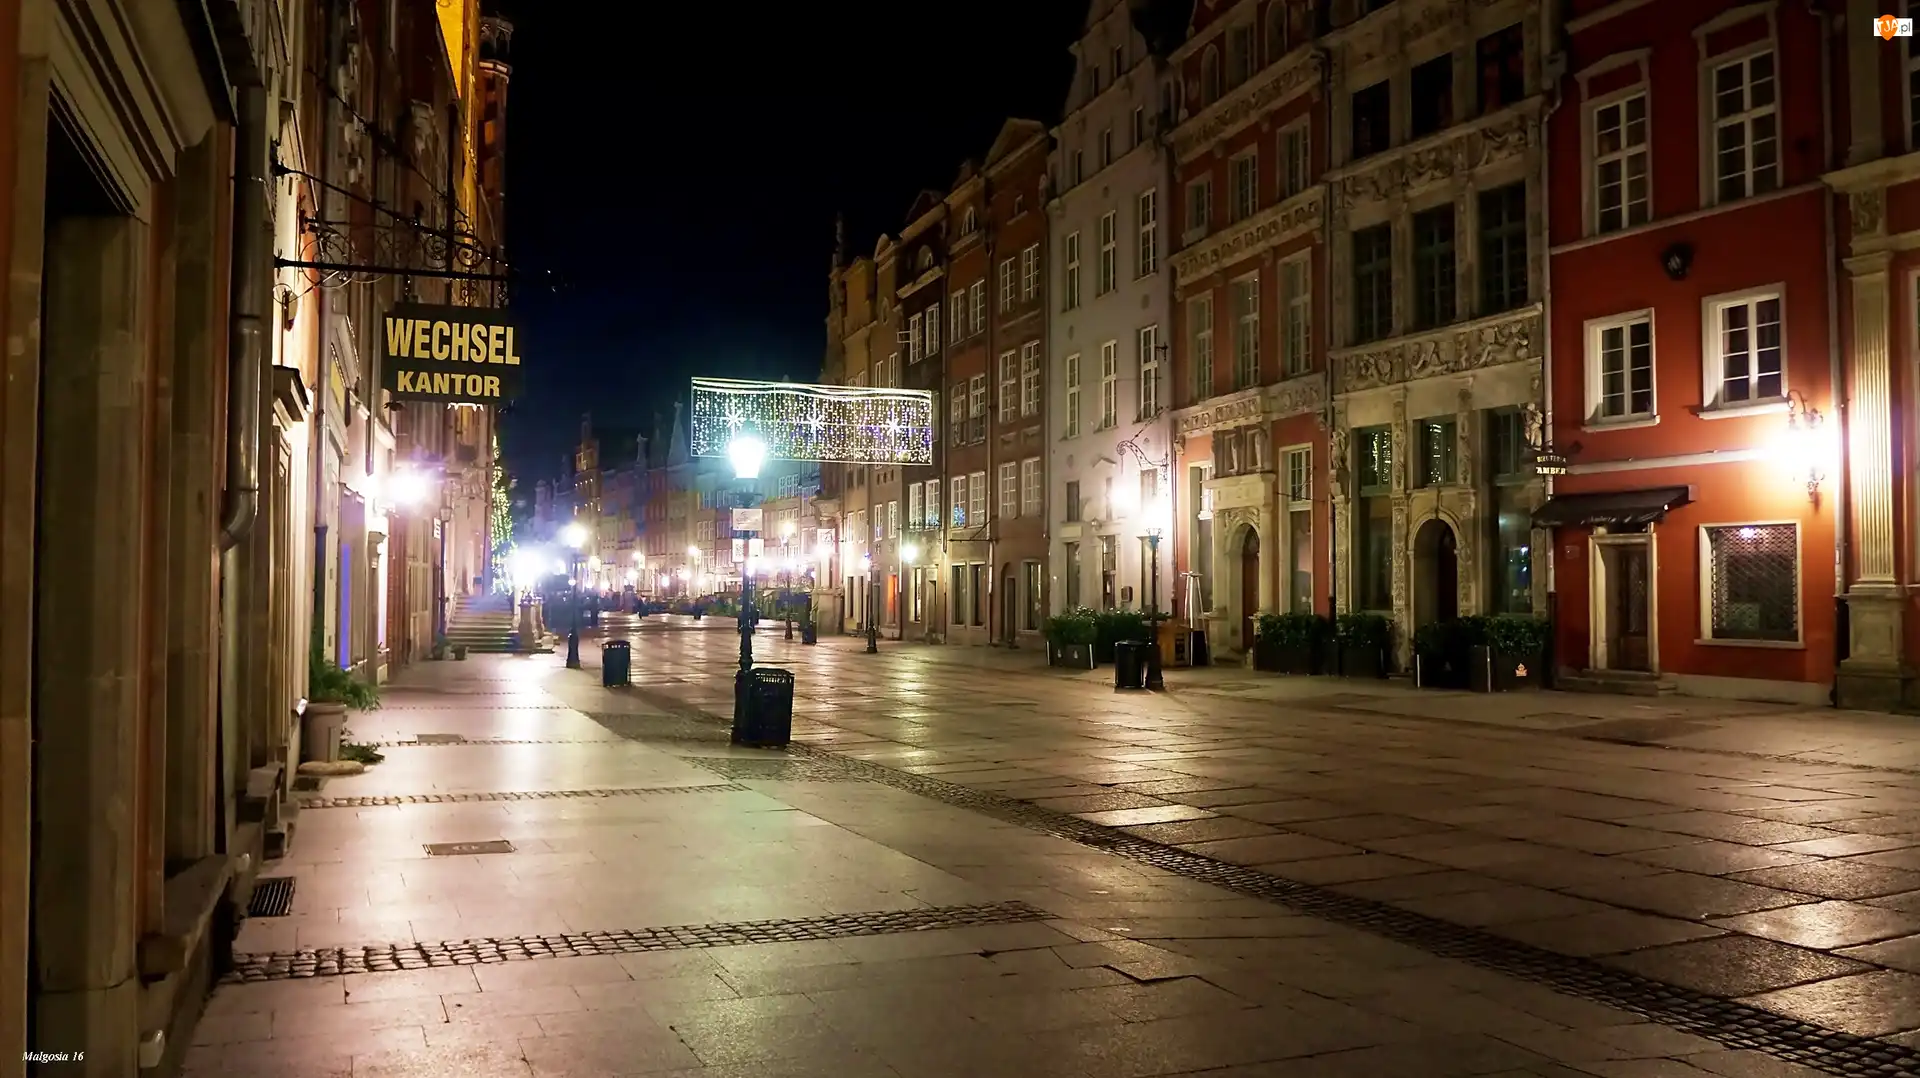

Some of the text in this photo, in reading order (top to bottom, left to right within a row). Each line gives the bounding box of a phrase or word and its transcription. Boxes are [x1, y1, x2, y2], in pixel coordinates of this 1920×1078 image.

[386, 317, 520, 365] WECHSEL
[397, 370, 500, 397] KANTOR
[1535, 466, 1566, 475] AMBER
